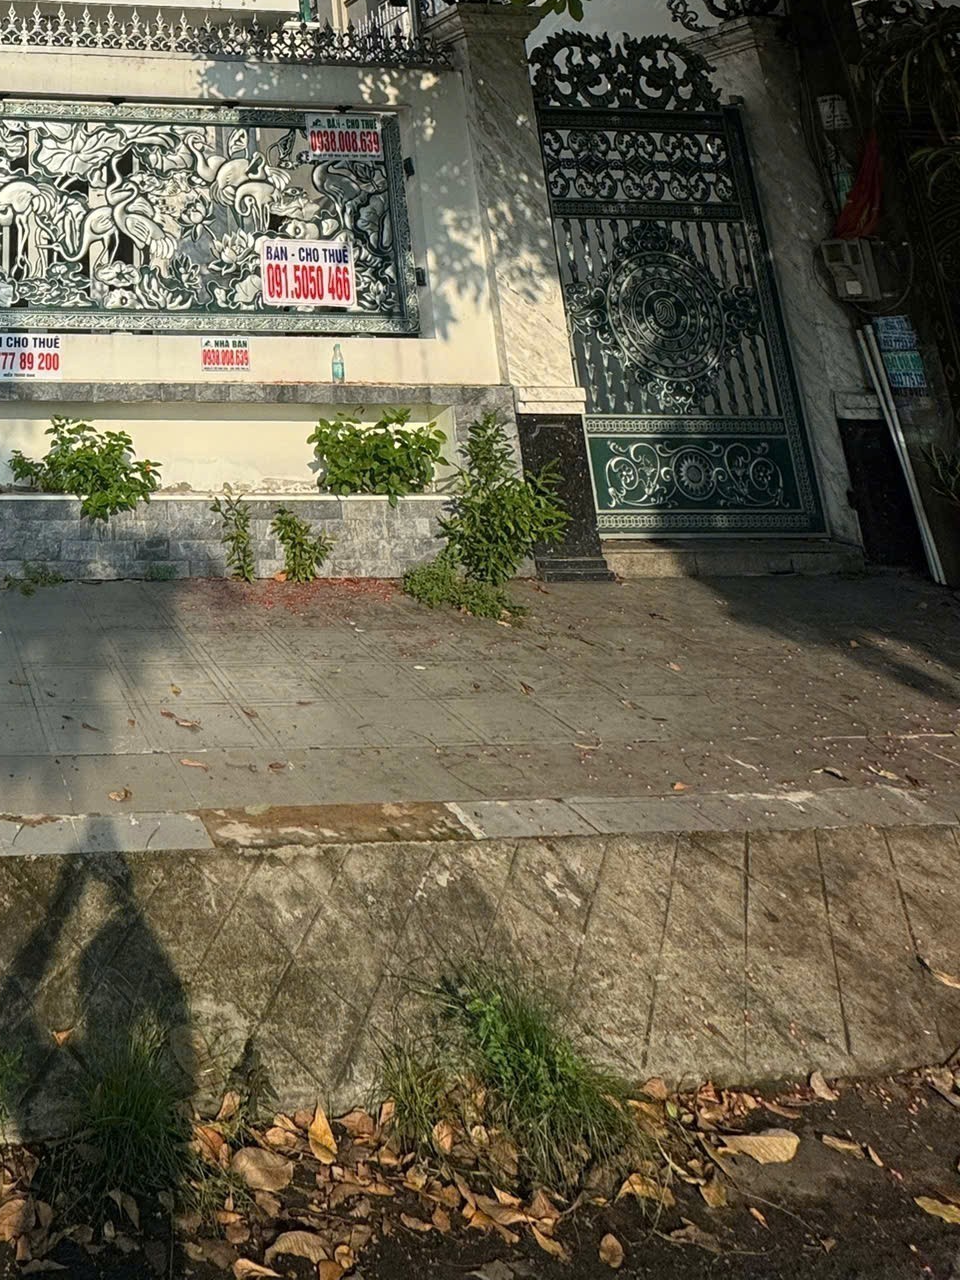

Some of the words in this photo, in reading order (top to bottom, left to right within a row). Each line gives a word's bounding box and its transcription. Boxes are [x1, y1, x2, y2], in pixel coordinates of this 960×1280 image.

[346, 118, 360, 129] CHO
[310, 130, 380, 153] 0938.008.639
[298, 247, 320, 263] CHO
[321, 245, 349, 263] THUÊ
[266, 263, 324, 300] 091.5050
[328, 265, 351, 301] 466
[6, 336, 29, 348] CHO
[32, 335, 60, 349] THUÊ
[19, 352, 34, 371] 89
[37, 352, 60, 371] 200
